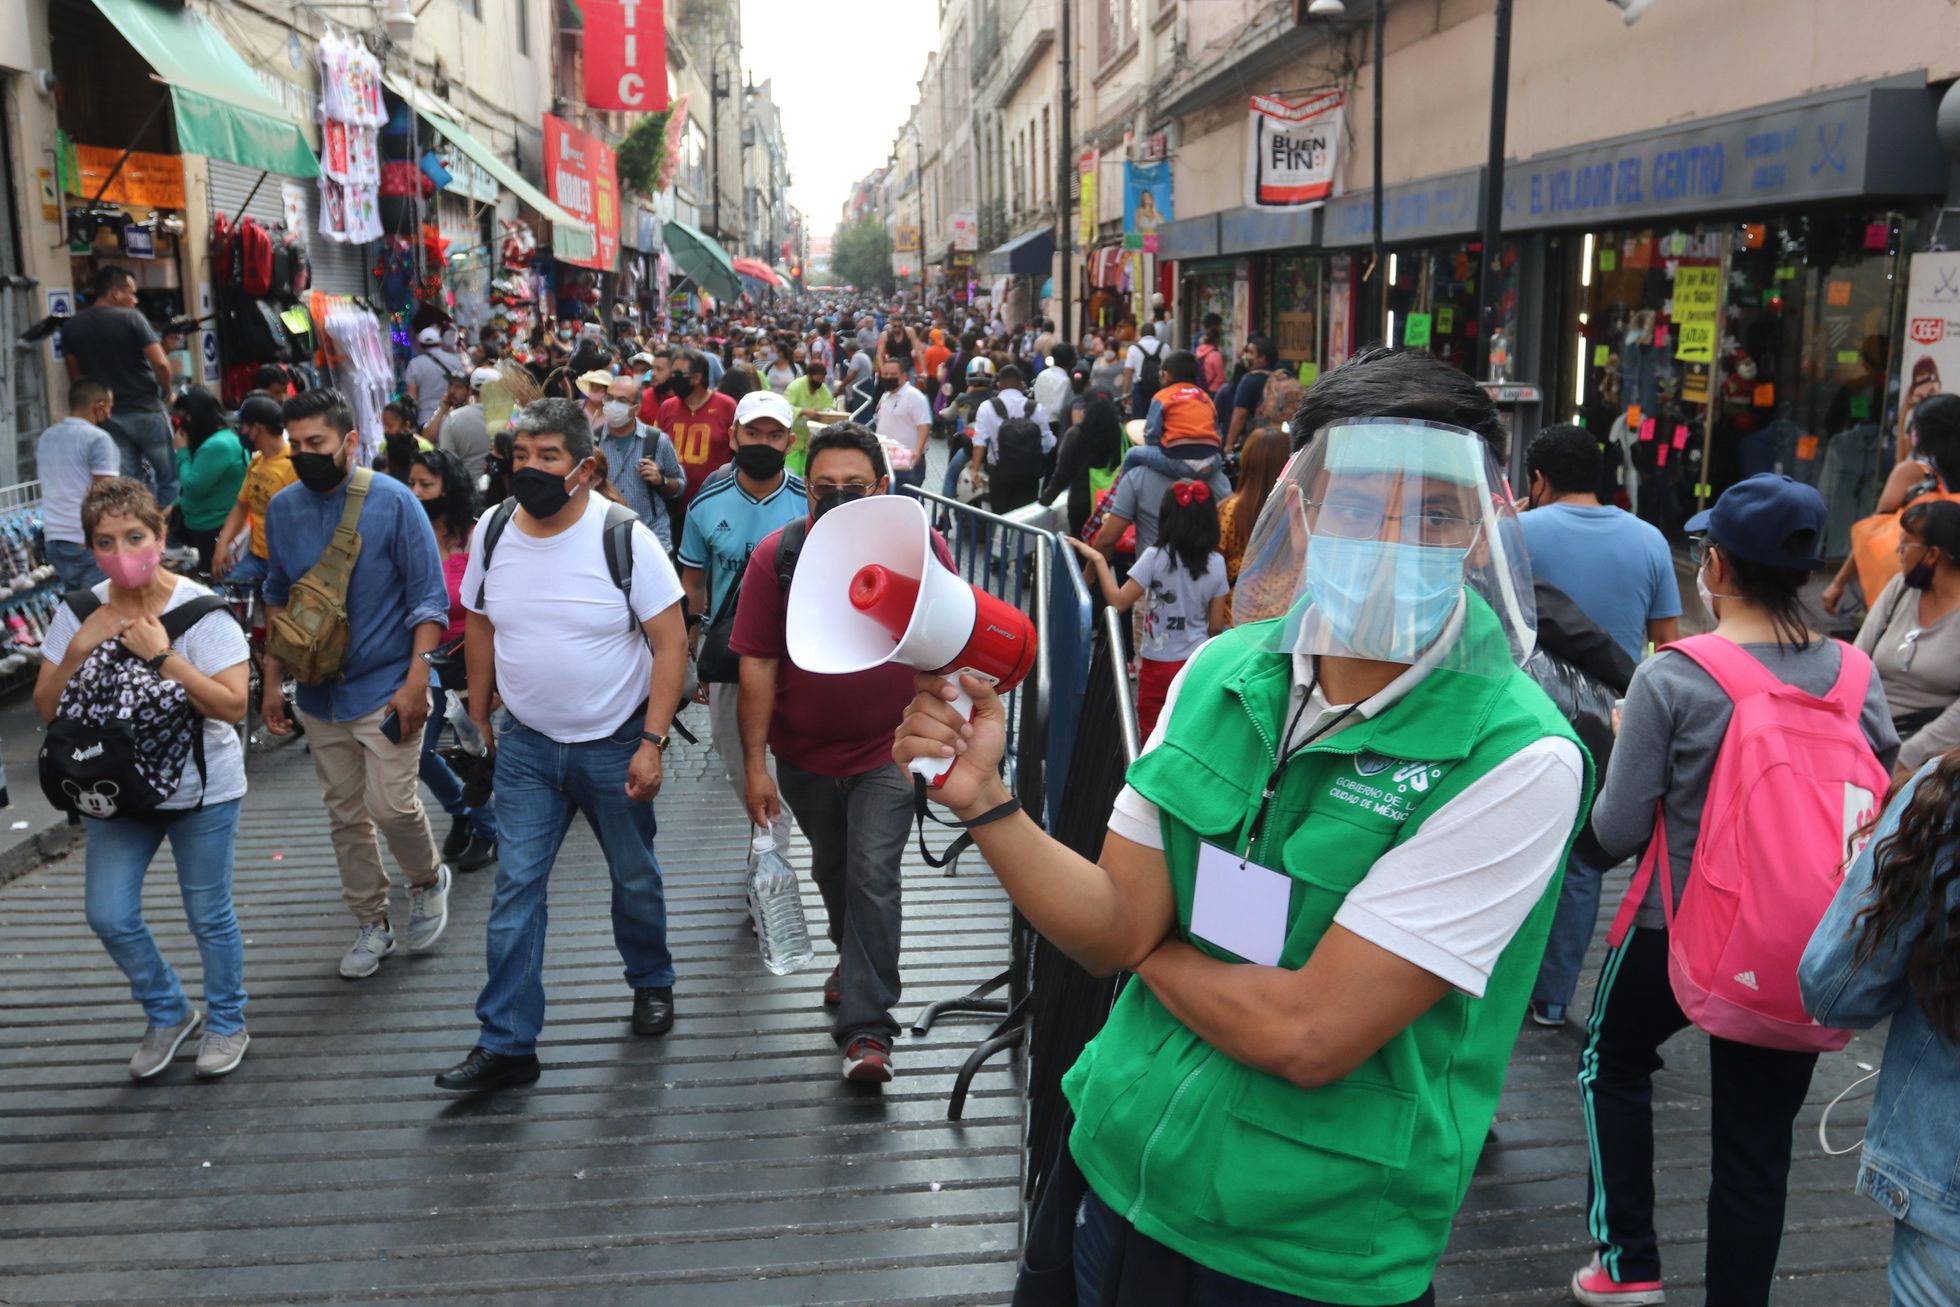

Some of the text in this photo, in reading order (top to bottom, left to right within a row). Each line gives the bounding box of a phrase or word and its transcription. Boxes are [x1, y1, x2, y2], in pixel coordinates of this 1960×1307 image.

[1273, 134, 1326, 151] BUEN
[1653, 142, 1725, 199] CENTRO
[673, 423, 711, 464] 10
[1329, 788, 1409, 821] CIUDAD DE MÉXIC
[1336, 777, 1416, 811] GOBIERNO DE L
